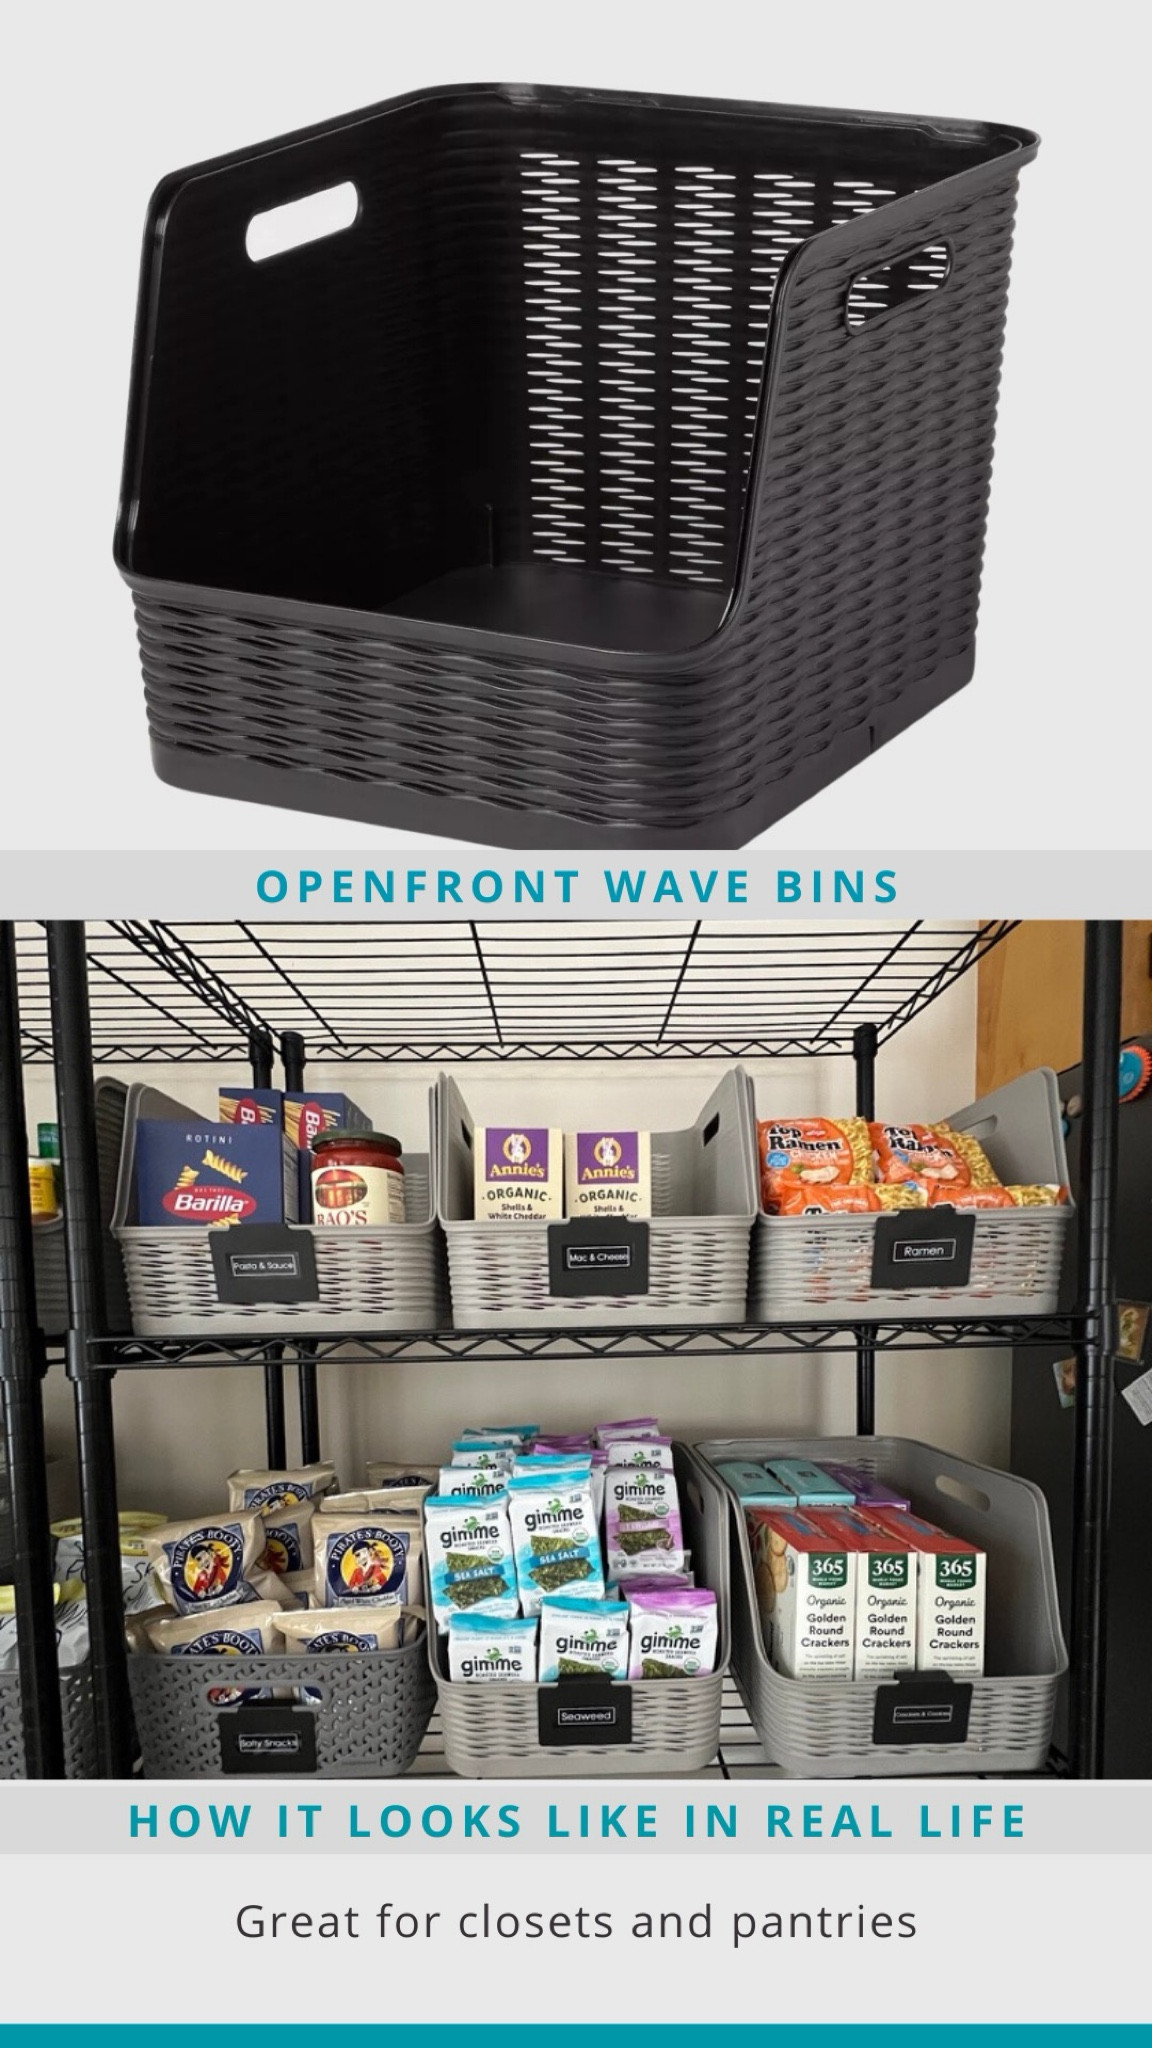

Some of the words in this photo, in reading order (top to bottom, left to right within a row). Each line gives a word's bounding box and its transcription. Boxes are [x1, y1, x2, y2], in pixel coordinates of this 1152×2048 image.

[185, 1134, 233, 1144] ROTINI
[769, 1136, 841, 1150] Ramen
[489, 1163, 545, 1178] Annie's
[580, 1165, 635, 1180] Annie's
[487, 1187, 548, 1202] ORGANIC
[579, 1189, 638, 1203] ORGANIC
[174, 1194, 244, 1212] Barilla
[501, 1203, 525, 1211] Shells
[317, 1209, 367, 1225] RAO'S
[488, 1212, 513, 1220] White
[514, 1212, 546, 1220] Cheddar
[569, 1254, 587, 1262] Mac
[597, 1252, 629, 1261] Cheese
[904, 1244, 944, 1257] Ramen
[614, 1481, 666, 1501] gimme
[525, 1508, 584, 1532] gimme
[440, 1525, 500, 1549] gimme
[375, 1531, 405, 1558] BOOTY
[558, 1551, 579, 1562] SALT
[473, 1568, 495, 1577] SALT
[812, 1557, 844, 1575] 365
[872, 1557, 904, 1576] 365
[939, 1559, 973, 1577] 365
[806, 1594, 847, 1609] Organic
[867, 1595, 908, 1610] Organic
[934, 1596, 976, 1611] Organic
[806, 1613, 846, 1623] Golden
[867, 1613, 908, 1623] Golden
[935, 1614, 976, 1624] Golden
[809, 1625, 844, 1635] Round
[870, 1626, 905, 1635] Round
[937, 1627, 973, 1637] Round
[222, 1632, 259, 1655] BOOT
[556, 1635, 617, 1653] gimme
[640, 1633, 701, 1654] gimme
[801, 1637, 850, 1647] Crackers
[862, 1638, 911, 1648] Crackers
[929, 1639, 980, 1649] Crackers
[461, 1658, 523, 1677] gimme
[561, 1711, 611, 1721] Seaweed
